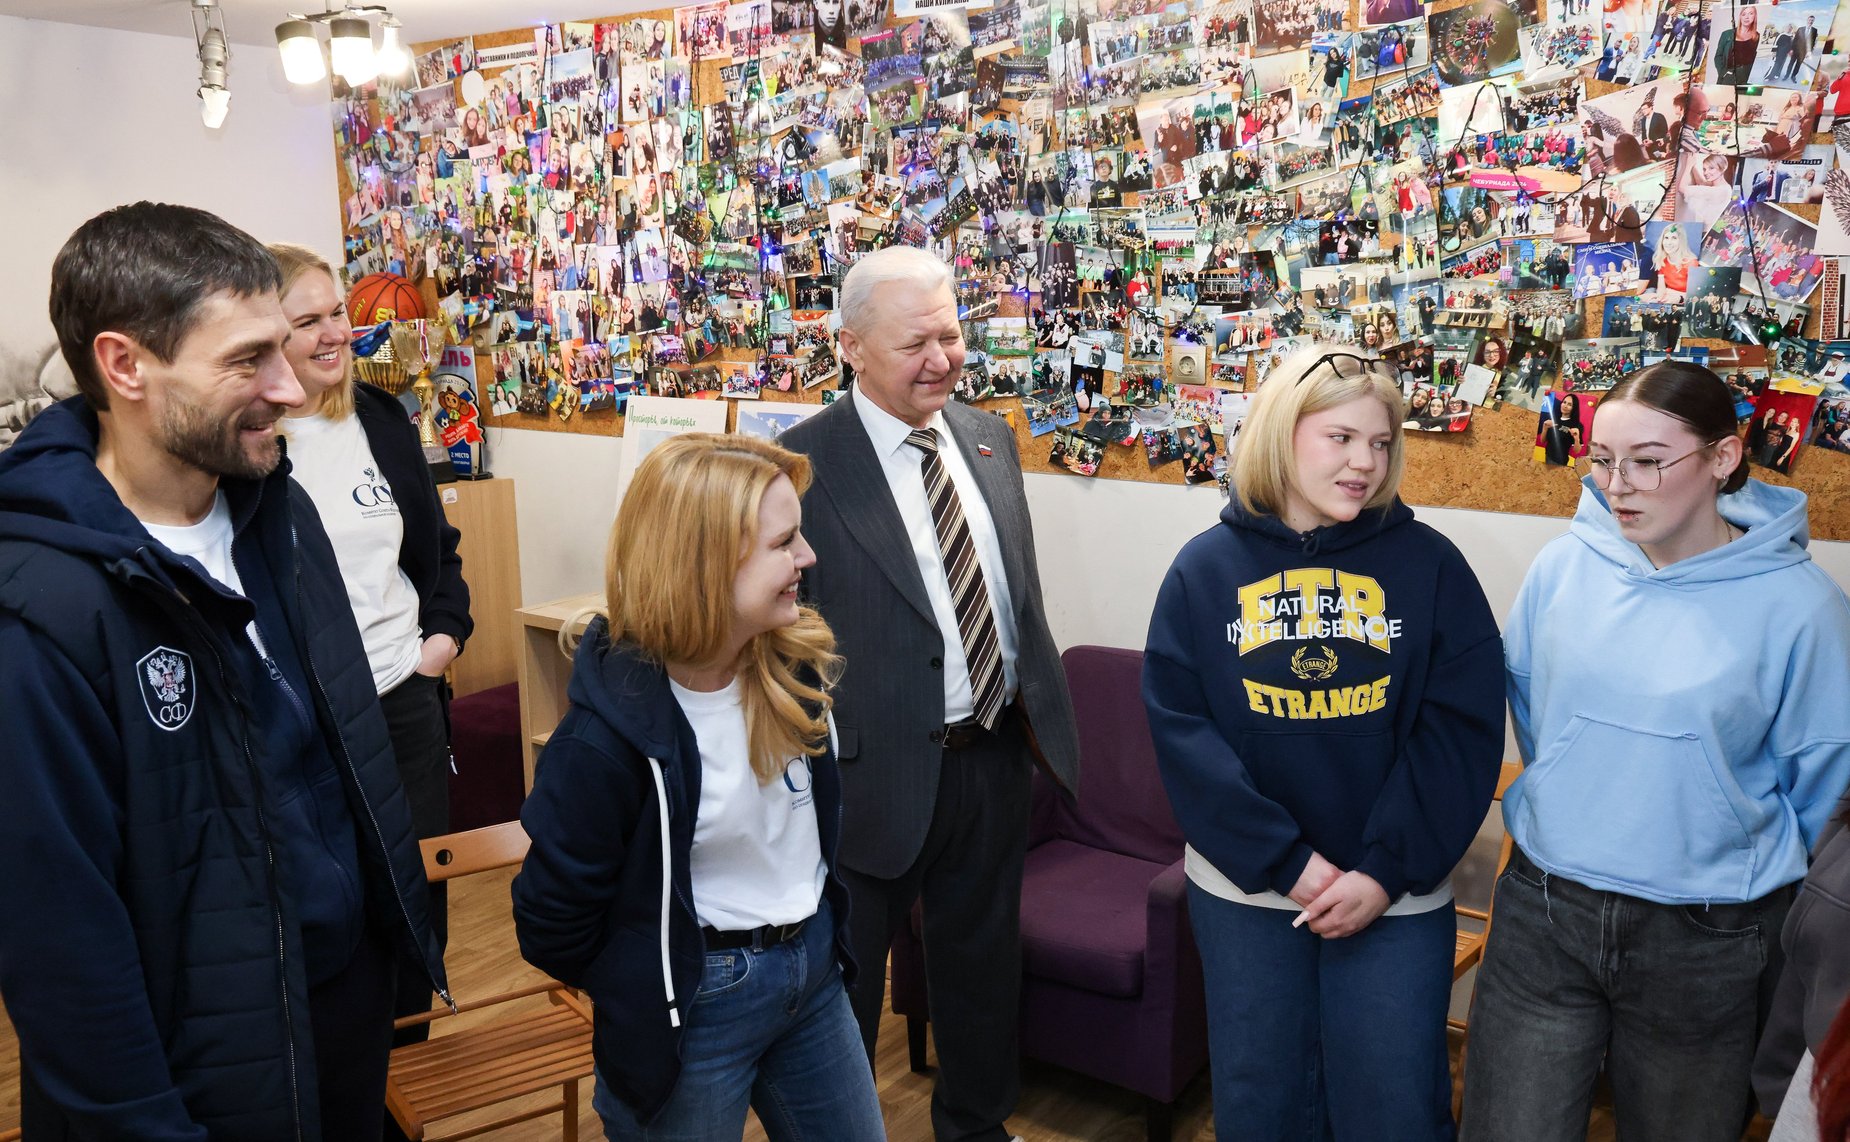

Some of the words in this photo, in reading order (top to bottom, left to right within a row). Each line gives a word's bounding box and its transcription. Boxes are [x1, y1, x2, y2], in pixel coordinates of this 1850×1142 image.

[915, 0, 934, 8] НАШИ
[1472, 179, 1510, 187] ЧЕБУРИАДА
[1259, 595, 1363, 617] NATURAL
[1227, 615, 1402, 645] INTELLIGENCE
[1302, 660, 1327, 670] ETRANGE
[1242, 675, 1391, 720] ETRANGE
